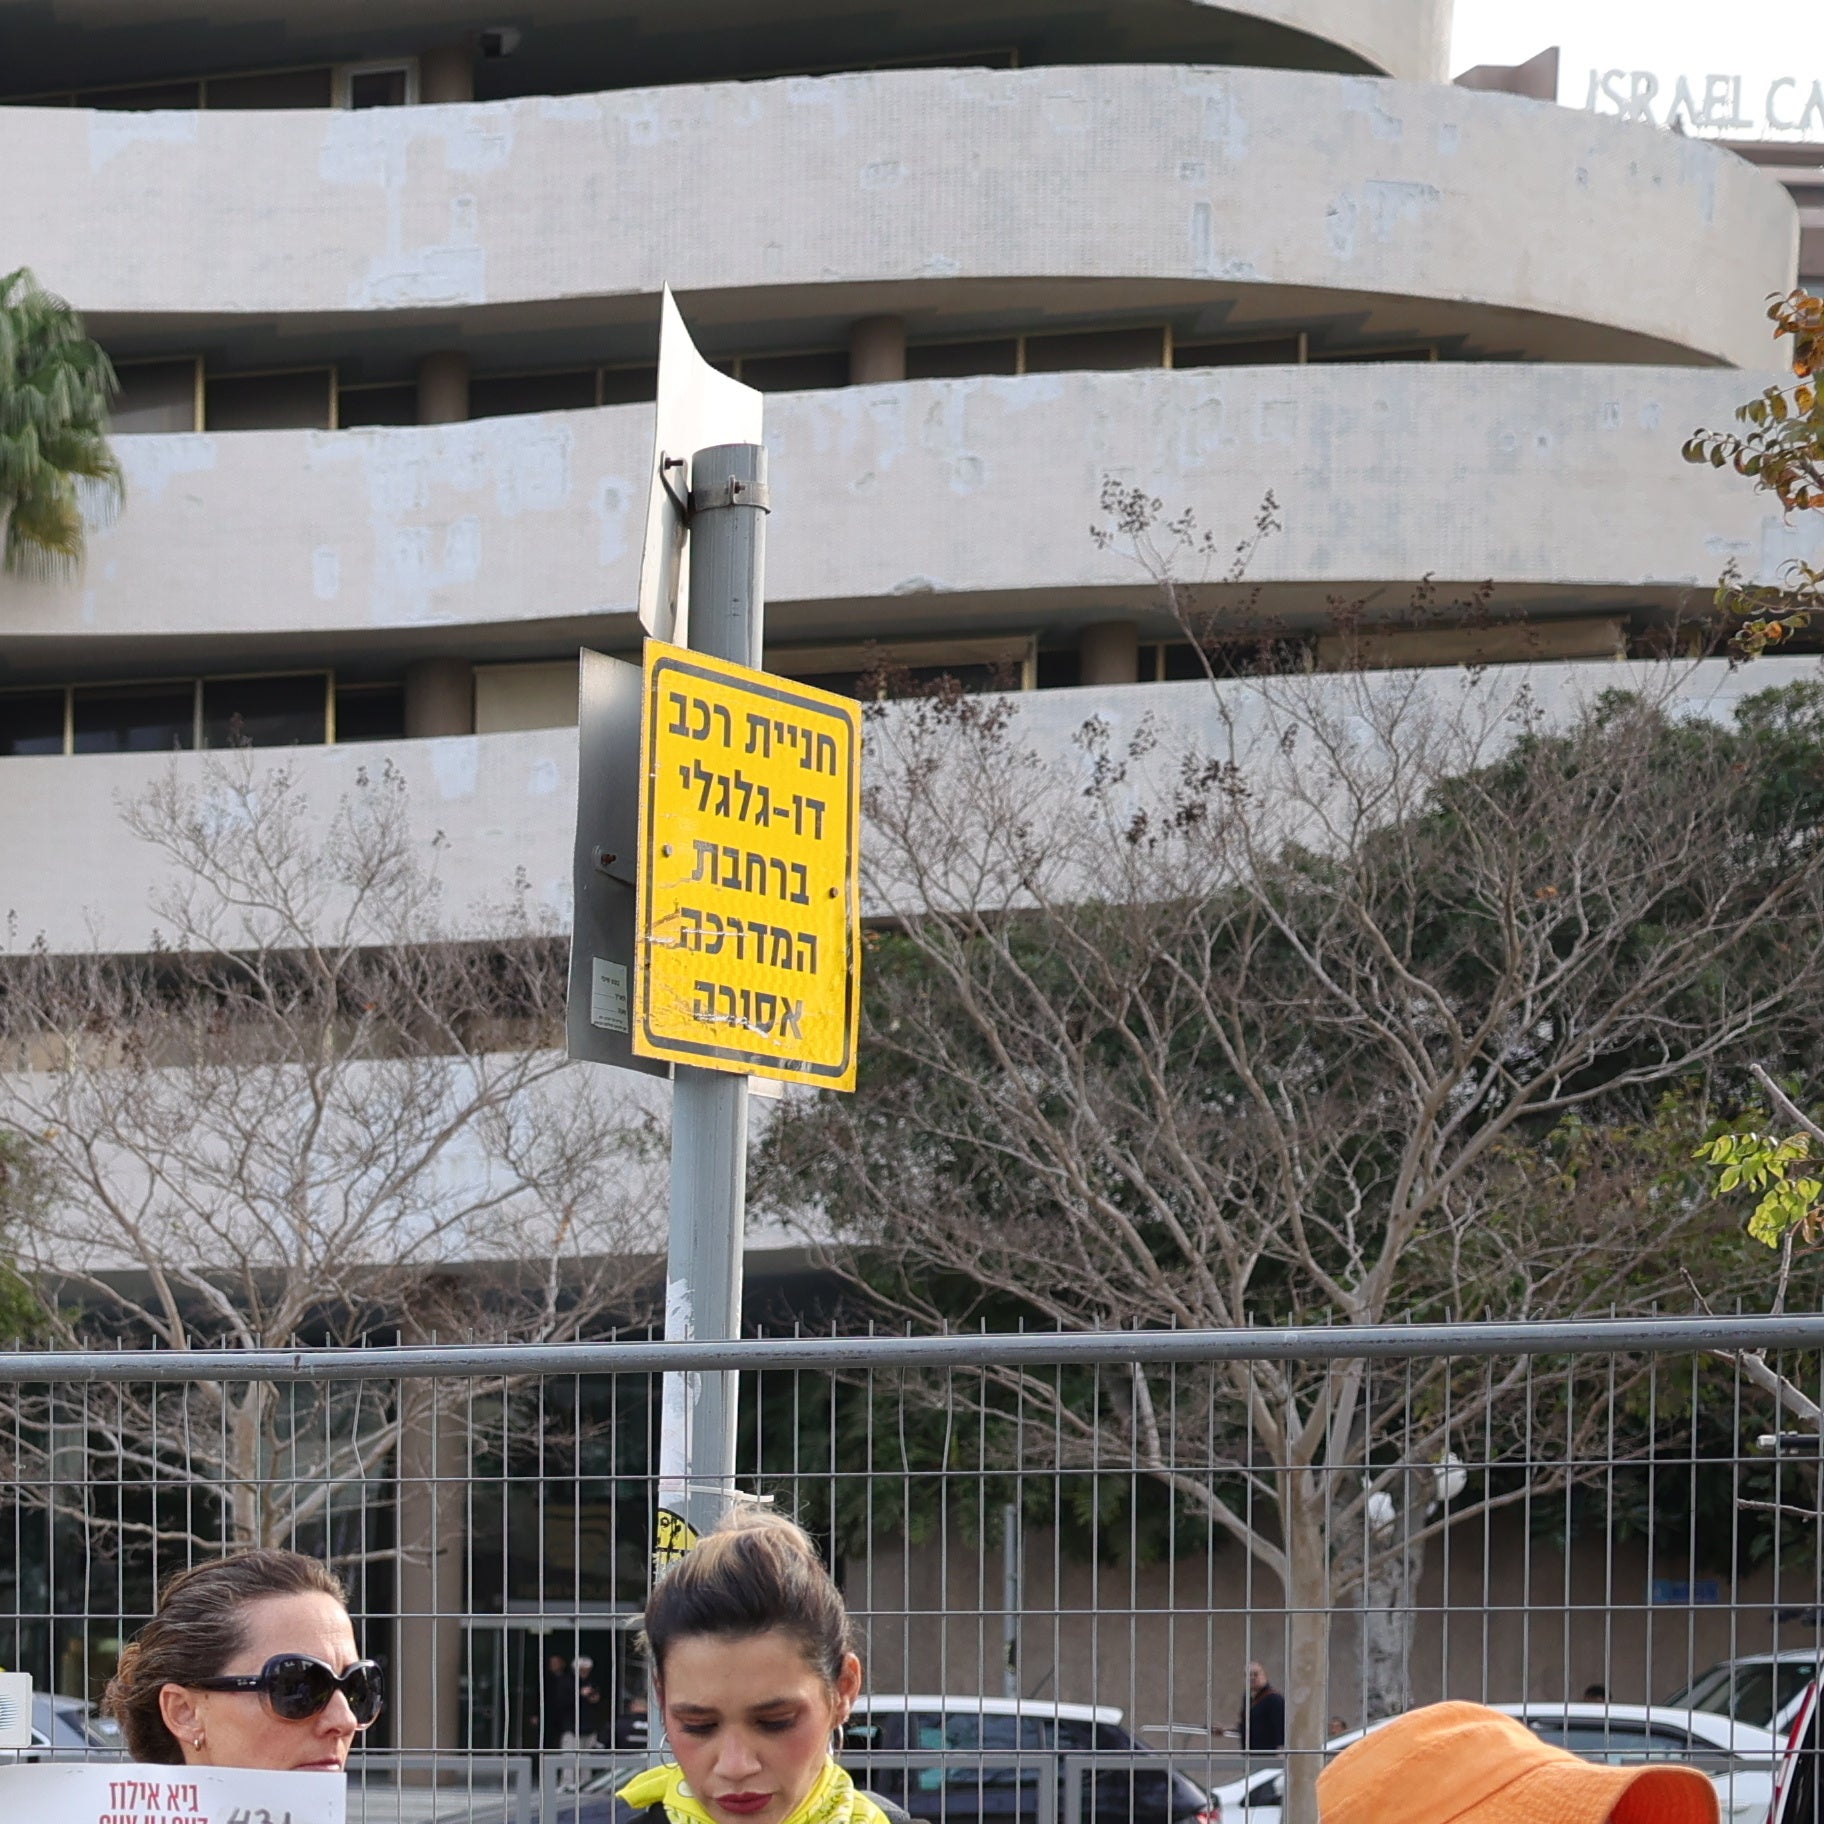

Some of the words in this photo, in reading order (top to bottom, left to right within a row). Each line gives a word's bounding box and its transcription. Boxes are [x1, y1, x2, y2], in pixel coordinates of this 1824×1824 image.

[1586, 68, 1754, 128] ISRAEL
[668, 691, 731, 748] רכב
[745, 712, 837, 776] חניית
[679, 758, 825, 841] דו-גלגלי
[692, 839, 810, 906] ברחבת
[679, 906, 817, 975] המדרכה
[693, 979, 803, 1040] אסורה
[109, 1780, 161, 1811] אילוז
[167, 1783, 199, 1813] גיא
